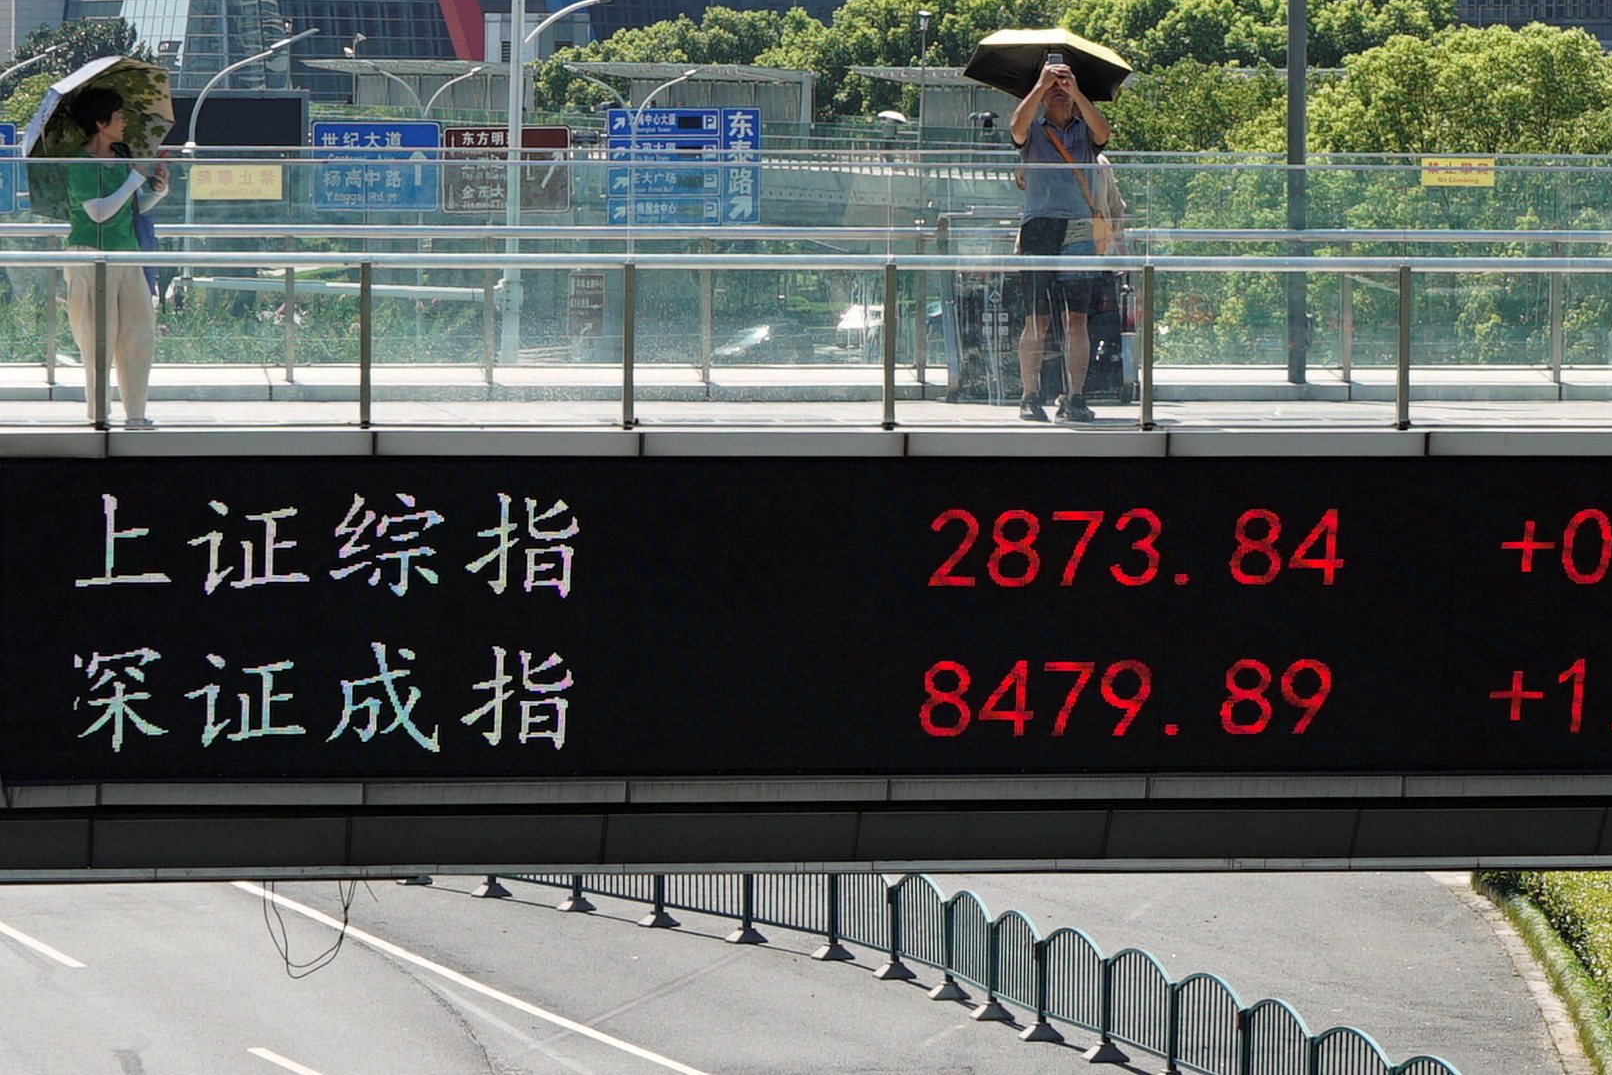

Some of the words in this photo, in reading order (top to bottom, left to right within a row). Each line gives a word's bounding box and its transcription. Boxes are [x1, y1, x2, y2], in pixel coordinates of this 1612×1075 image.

[321, 131, 402, 148] 世纪大道
[461, 131, 509, 146] 东方明
[728, 111, 754, 195] 东泰路
[323, 169, 402, 188] 杨高中路
[325, 192, 364, 204] Yangga
[461, 183, 505, 200] 金茂大
[75, 492, 580, 599] 上证综指
[73, 642, 574, 753] 深证成指
